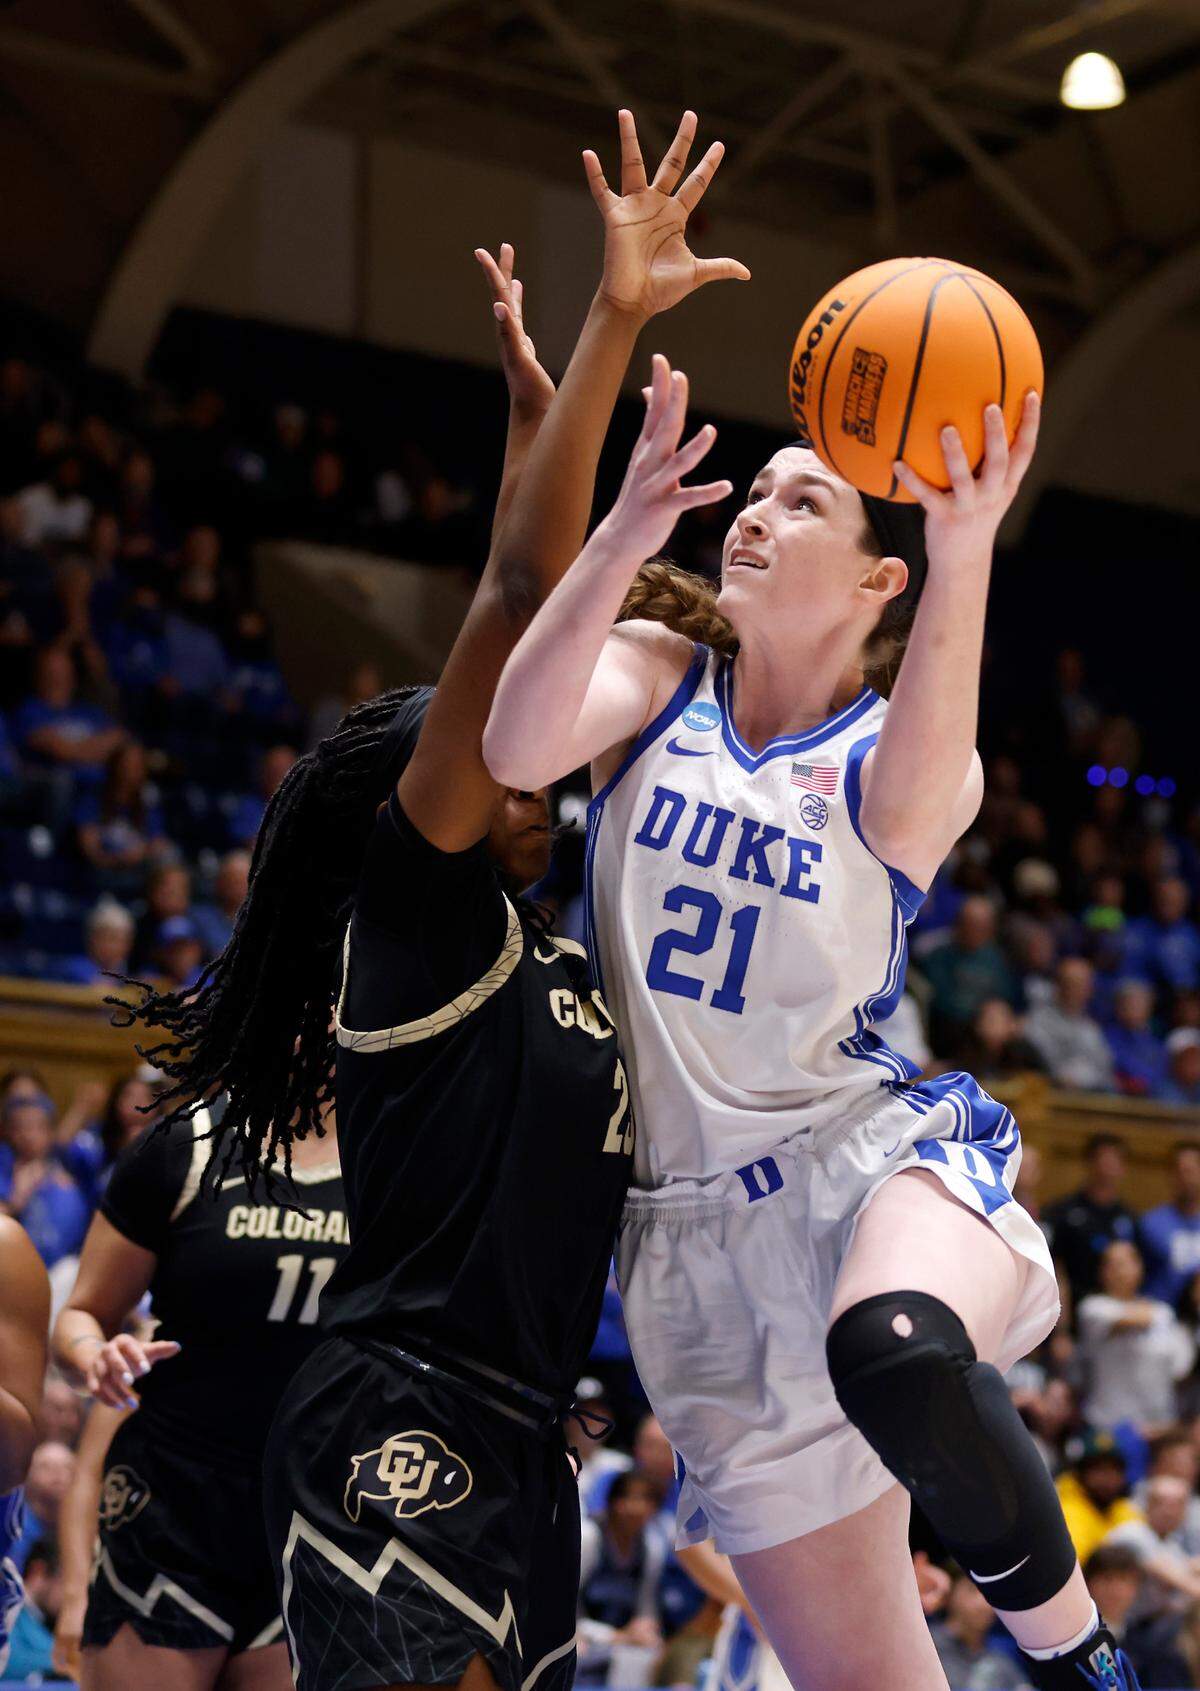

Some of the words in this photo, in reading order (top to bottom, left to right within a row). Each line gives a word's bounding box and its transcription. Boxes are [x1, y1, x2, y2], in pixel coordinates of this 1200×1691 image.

[685, 710, 717, 727] NCAA
[803, 804, 825, 820] ACC
[634, 786, 823, 904] DUKE
[646, 884, 761, 1014] 21
[734, 1156, 784, 1203] D
[225, 1204, 350, 1246] COLORA
[266, 1254, 336, 1325] 11
